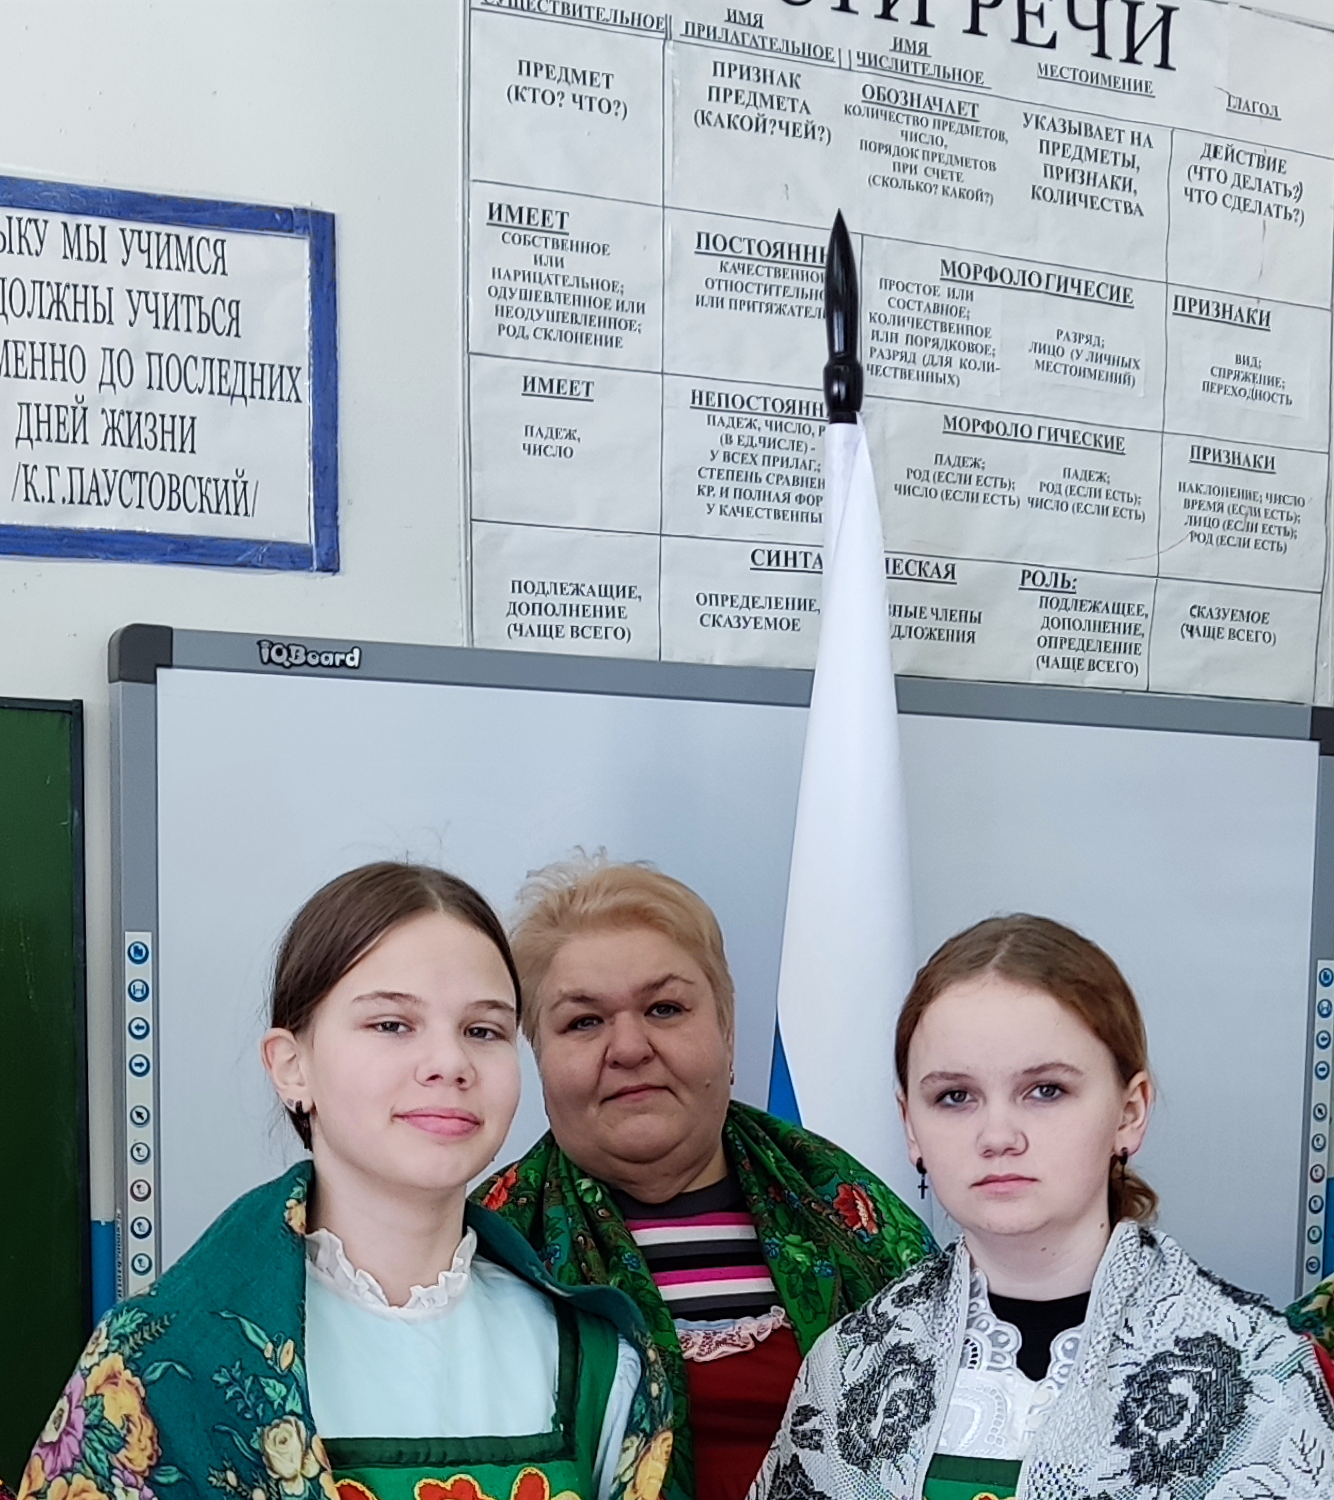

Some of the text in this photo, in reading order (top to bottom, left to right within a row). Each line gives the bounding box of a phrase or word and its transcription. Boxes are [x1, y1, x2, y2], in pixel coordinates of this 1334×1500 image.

[726, 7, 764, 28] ИМЯ
[683, 21, 835, 61] ПРИЛАГАТЕЛЬНОЕ
[892, 37, 929, 56] ИМЯ
[517, 59, 614, 90] ПРЕДМЕТ
[712, 61, 802, 90] ПРИЗНАК
[856, 50, 985, 86] ЧИСЛИТЕЛЬНОЕ
[1037, 62, 1155, 94] МЕСТОИМЕНИЕ
[506, 83, 628, 120] (КТО? ЧТО?)
[707, 85, 811, 115] ПРЕДМЕТА
[861, 84, 979, 119] ОБОЗНАЧАЕТ
[1227, 93, 1280, 118] ГЛАГОЛ
[1022, 112, 1154, 150] УКАЗЫВАЕТ НА
[1038, 139, 1141, 172] ПРЕДМЕТЫ,
[1199, 142, 1287, 175] ДЕЙСТВИЕ
[1043, 163, 1138, 196] ПРИЗНАКИ,
[1187, 163, 1303, 202] (ЧТО ДЕЛАТЬ?)
[1030, 185, 1144, 218] КОЛИЧЕСТВА
[1184, 187, 1305, 227] ЧТО СДЕЛАТЬ?)
[487, 202, 570, 231] ИМЕЕТ
[61, 222, 108, 265] МЫ
[119, 227, 228, 276] УЧИМСЯ
[501, 231, 611, 256] СОБСТВЕННОЕ
[125, 288, 242, 339] УЧИТЬСЯ
[1173, 295, 1272, 327] ПРИЗНАКИ
[98, 347, 134, 392] ДО
[145, 351, 303, 406] ПОСЛЕДНИХ
[522, 375, 595, 398] ИМЕЕТ
[15, 394, 197, 455] ДНЕЙ ЖИЗНИ
[523, 425, 581, 442] ПАДЕЖ,
[523, 443, 574, 459] ЧИСЛО
[1190, 445, 1276, 471] ПРИЗНАКИ
[510, 580, 642, 602] ПОДЛЕЖАЩИЕ,
[1019, 569, 1077, 592] РОЛЬ:
[506, 601, 628, 620] ДОПОЛНЕНИЕ
[695, 592, 820, 614] ОПРЕДЕЛЕНИЕ,
[1038, 596, 1149, 619] ПОДЛЕЖАЩЕЕ,
[507, 623, 631, 644] (ЧАЩЕ ВСЕГО)
[699, 613, 801, 632] СКАЗУЕМОЕ
[1040, 615, 1145, 638] ДОПОЛНЕНИЕ,
[1036, 636, 1142, 656] ОПРЕДЕЛЕНИЕ
